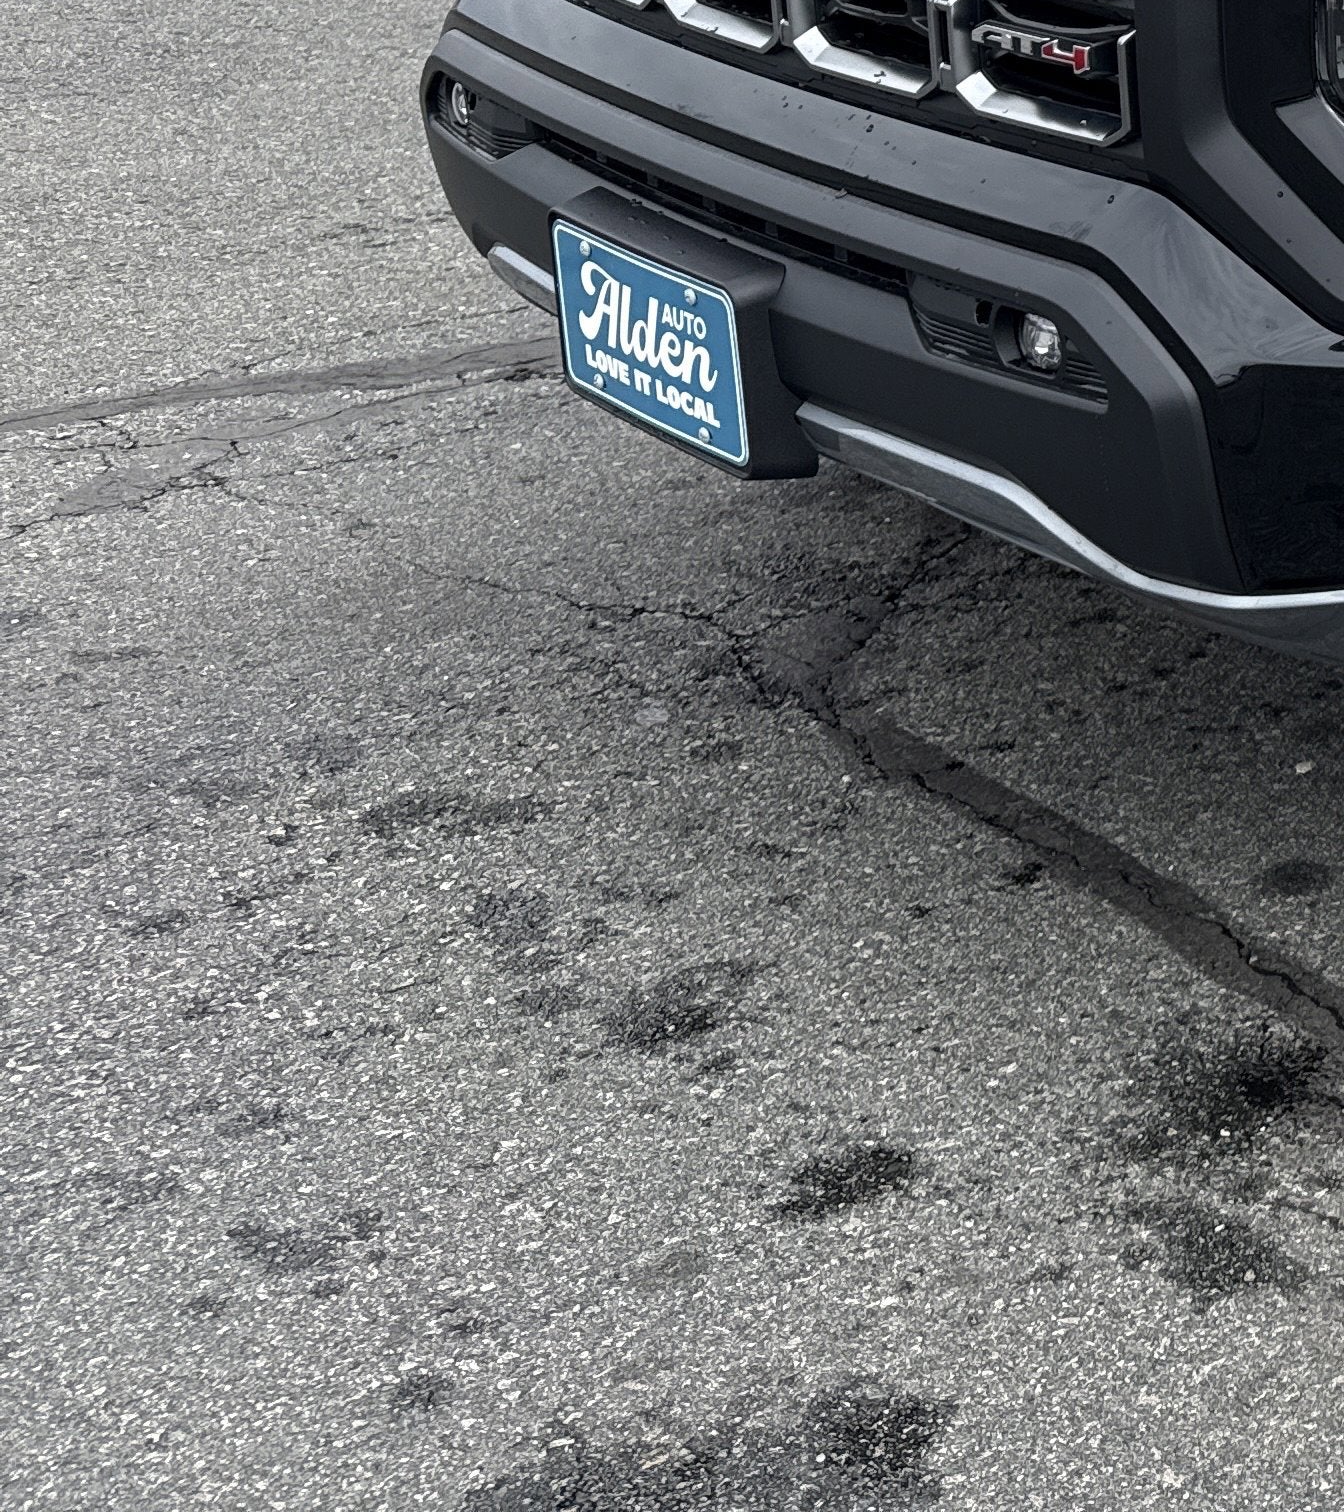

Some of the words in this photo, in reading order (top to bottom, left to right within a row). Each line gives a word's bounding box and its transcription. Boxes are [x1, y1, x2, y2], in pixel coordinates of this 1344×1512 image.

[972, 24, 1091, 74] AT4
[579, 260, 719, 393] Alden
[661, 303, 707, 340] AUTO
[585, 344, 631, 386] LOVE
[633, 368, 652, 396] IT
[655, 379, 721, 429] LOCAL
